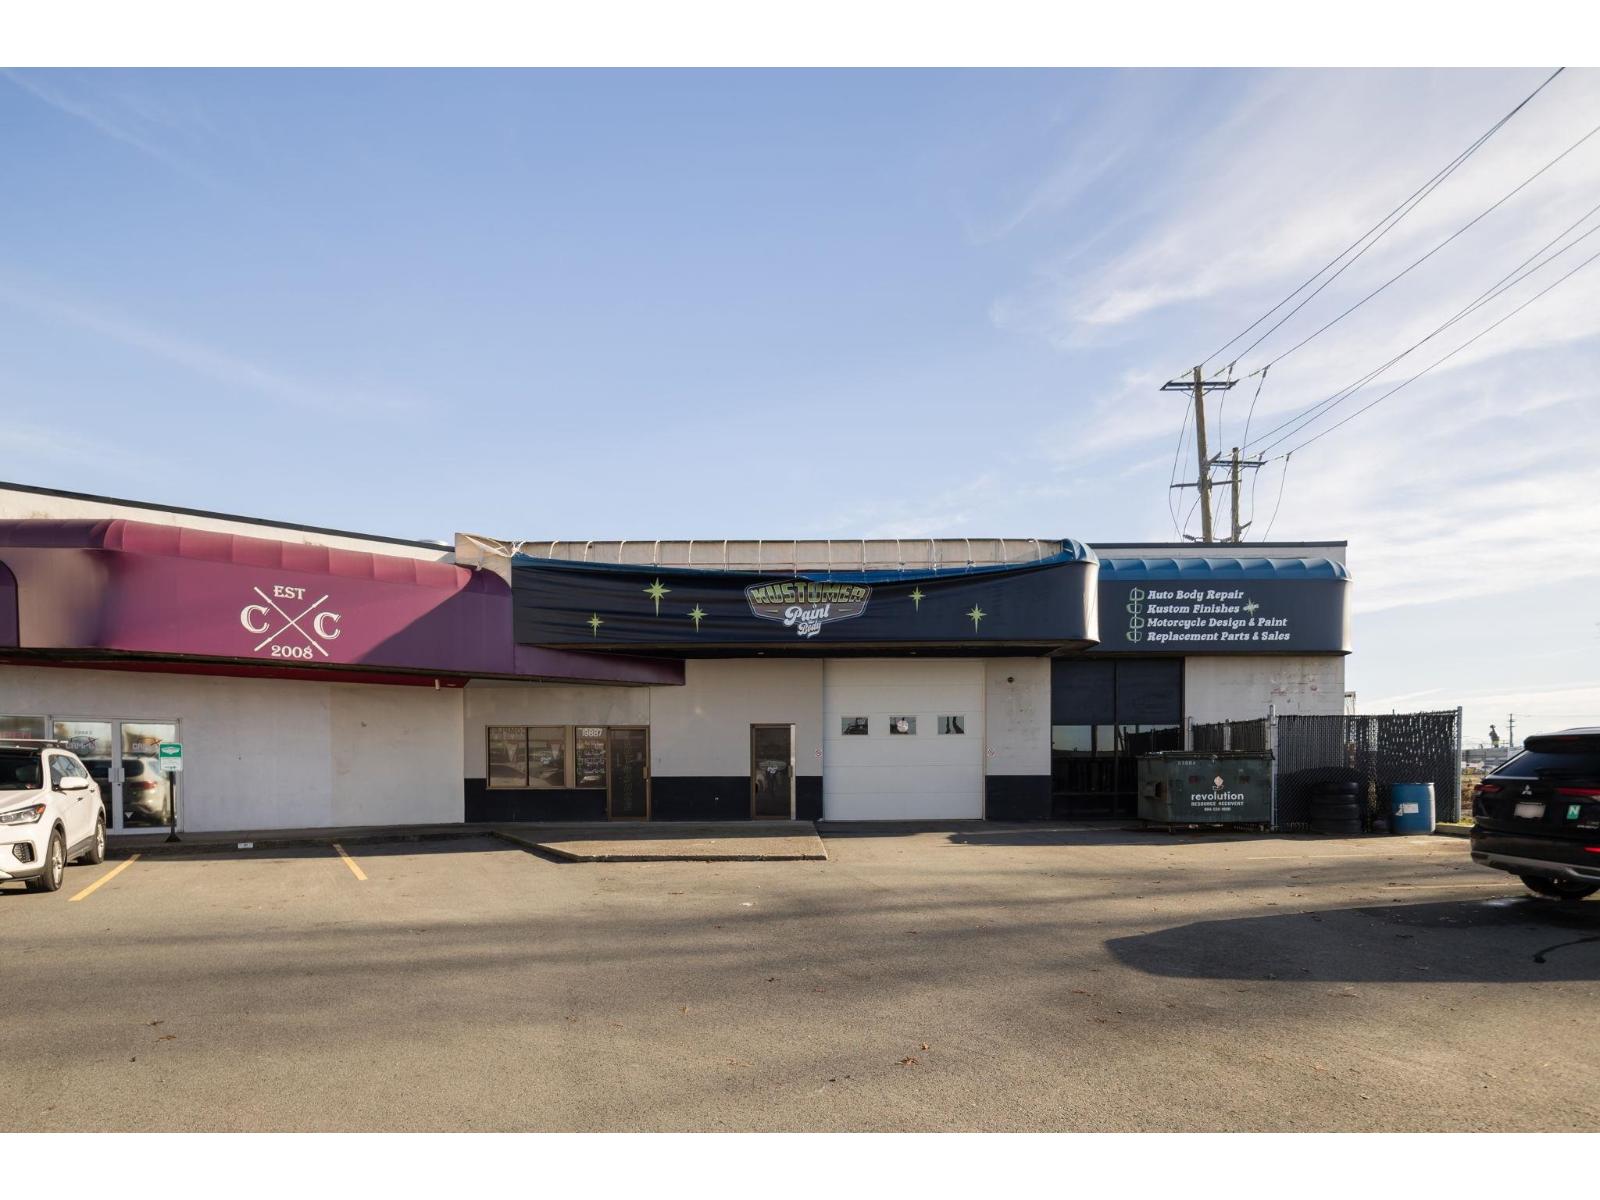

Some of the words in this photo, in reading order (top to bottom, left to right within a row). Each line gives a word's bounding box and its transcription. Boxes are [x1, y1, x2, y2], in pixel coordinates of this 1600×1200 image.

[273, 585, 306, 600] EST
[1147, 590, 1174, 599] Auto
[1176, 590, 1203, 601] Body
[1206, 590, 1244, 601] Repair
[784, 603, 830, 627] Paint
[1147, 604, 1190, 613] Kustom
[1192, 604, 1240, 613] Finishes
[240, 604, 270, 634] C
[313, 611, 341, 640] C
[1147, 618, 1206, 629] Motorcycle
[1208, 618, 1247, 629] Design
[1248, 618, 1255, 627] &
[1257, 617, 1288, 627] Paint
[797, 619, 821, 639] Body
[1147, 632, 1218, 643] Replacement
[1220, 631, 1250, 641] Parts
[1252, 632, 1259, 641] &
[1261, 631, 1290, 641] Sales
[271, 644, 313, 660] 2008
[1191, 791, 1244, 801] revolution
